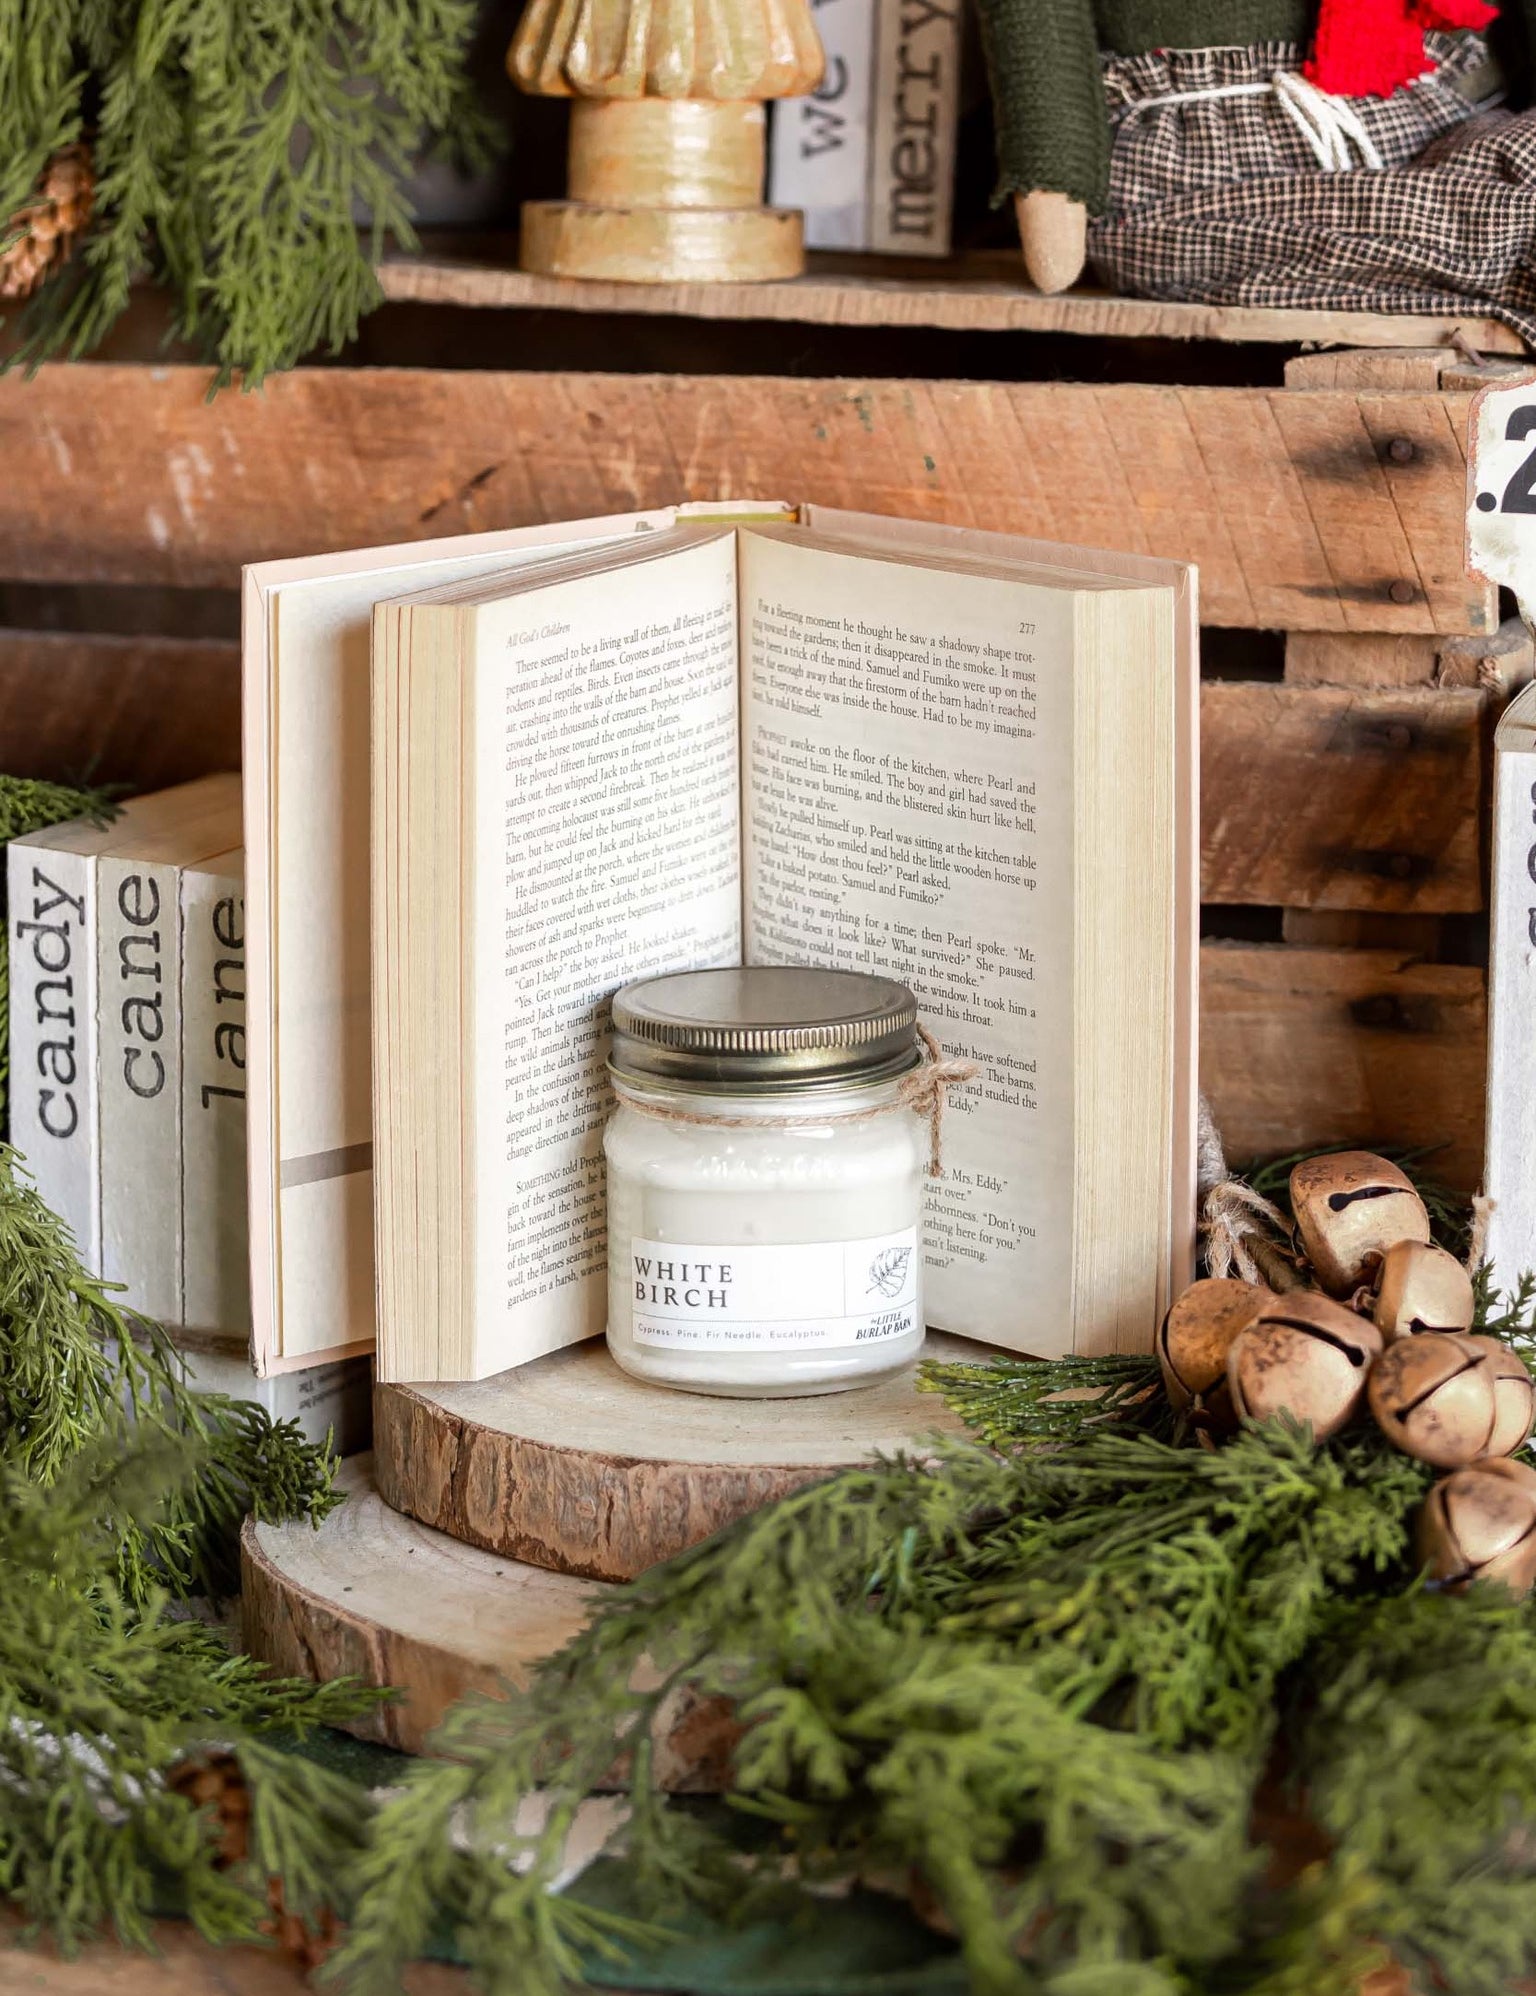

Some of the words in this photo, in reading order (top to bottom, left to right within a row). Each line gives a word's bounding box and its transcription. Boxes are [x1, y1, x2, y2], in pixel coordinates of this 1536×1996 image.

[889, 0, 956, 239] merry
[541, 622, 571, 640] Children
[805, 615, 840, 630] moment
[857, 622, 892, 642] thought
[939, 637, 979, 658] shadowy
[983, 644, 1010, 662] shape
[1014, 650, 1035, 662] trot-
[1019, 622, 1036, 636] 277
[516, 659, 537, 674] There
[540, 649, 568, 668] seemed
[804, 632, 839, 650] gardens;
[842, 638, 861, 652] then
[874, 643, 929, 665] disappeared
[963, 661, 997, 676] smoke.
[1012, 670, 1036, 682] must
[838, 657, 863, 671] mind.
[866, 659, 899, 678] Samuel
[923, 670, 959, 688] Fumiko
[962, 680, 985, 692] were
[829, 672, 845, 686] that
[865, 678, 907, 698] firestorm
[940, 692, 960, 707] barn
[964, 696, 994, 713] hadn't
[998, 705, 1036, 720] reached
[560, 715, 598, 736] thousands
[842, 694, 869, 709] inside
[890, 702, 919, 719] house.
[923, 708, 943, 723] Had
[993, 722, 1035, 739] imagina-
[549, 744, 569, 758] horse
[572, 732, 599, 752] toward
[616, 719, 654, 739] onrushing
[530, 762, 557, 786] plowed
[560, 758, 584, 773] fifteen
[587, 748, 618, 766] furrows
[564, 770, 597, 792] whipped
[600, 765, 617, 784] Jack
[853, 749, 875, 765] floor
[912, 761, 949, 782] kitchen,
[953, 770, 982, 786] where
[987, 775, 1011, 791] Pearl
[547, 799, 570, 815] create
[579, 785, 606, 805] second
[833, 763, 848, 778] He
[850, 769, 883, 785] smiled.
[887, 774, 904, 789] The
[908, 778, 924, 797] boy
[949, 788, 964, 802] girl
[968, 790, 986, 805] had
[990, 797, 1016, 810] saved
[523, 821, 560, 840] oncoming
[562, 808, 598, 829] holocaust
[617, 796, 630, 812] still
[823, 779, 861, 802] burning,
[903, 796, 943, 816] blistered
[947, 805, 966, 820] skin
[970, 809, 990, 824] hurt
[994, 813, 1011, 828] like
[1015, 817, 1036, 835] hell,
[556, 831, 577, 850] could
[611, 815, 642, 833] burning
[870, 825, 892, 841] Pearl
[915, 837, 942, 855] sitting
[975, 846, 1009, 865] kitchen
[1013, 855, 1036, 870] table
[529, 869, 572, 895] dismounted
[626, 849, 649, 864] where
[543, 851, 571, 875] jumped
[598, 838, 616, 858] Jack
[837, 839, 867, 854] smiled
[890, 848, 909, 863] held
[930, 856, 950, 872] little
[953, 864, 991, 880] wooden
[994, 868, 1020, 885] horse
[842, 857, 863, 872] thou
[866, 861, 891, 877] feel?"
[896, 867, 918, 884] Pearl
[922, 874, 950, 890] asked.
[841, 873, 875, 892] Samuel
[899, 886, 944, 906] Fumiko?"
[546, 905, 575, 926] covered
[505, 939, 536, 958] showers
[579, 916, 603, 936] sparks
[560, 939, 582, 962] porch
[595, 927, 626, 947] Prophet
[820, 908, 860, 929] anything
[893, 923, 916, 940] time;
[922, 928, 941, 943] then
[947, 933, 971, 949] Pearl
[976, 942, 1007, 957] spoke.
[1013, 946, 1035, 963] "Mr.
[838, 926, 858, 943] look
[864, 932, 886, 949] like?
[891, 938, 915, 955] What
[921, 948, 970, 966] survived?"
[976, 957, 993, 972] She
[999, 965, 1035, 981] paused.
[855, 950, 869, 963] tell
[873, 952, 888, 968] last
[891, 959, 914, 975] night
[946, 972, 984, 987] smoke."
[118, 874, 165, 1099] cane
[573, 973, 600, 991] mother
[17, 866, 86, 1138] candy
[537, 1003, 554, 1023] Jack
[557, 993, 584, 1014] toward
[930, 986, 969, 1004] window.
[983, 996, 1005, 1011] took
[567, 1008, 592, 1029] turned
[962, 1009, 992, 1027] throat.
[540, 1036, 569, 1057] animals
[573, 1028, 601, 1049] parting
[942, 1042, 968, 1059] might
[971, 1046, 993, 1063] have
[996, 1054, 1036, 1073] softened
[542, 1071, 579, 1092] confusion
[987, 1068, 1004, 1084] The
[1007, 1072, 1036, 1091] barns.
[526, 1096, 558, 1116] shadows
[572, 1100, 600, 1118] drifting
[948, 1094, 978, 1115] Eddy."
[985, 1088, 1019, 1105] studied
[534, 1129, 568, 1150] direction
[952, 1168, 972, 1185] Mrs.
[976, 1174, 1007, 1195] Eddy."
[529, 1203, 555, 1225] toward
[573, 1192, 594, 1208] house
[527, 1219, 569, 1245] implements
[571, 1213, 588, 1227] over
[983, 1212, 1014, 1232] "Don't
[1018, 1224, 1035, 1238] you
[531, 1243, 550, 1262] night
[566, 1247, 592, 1265] searing
[634, 1255, 733, 1283] WHITE
[635, 1281, 728, 1308] BIRCH
[856, 1323, 893, 1340] BURLAP
[893, 1316, 912, 1334] BARN
[877, 1311, 903, 1325] LITTLE
